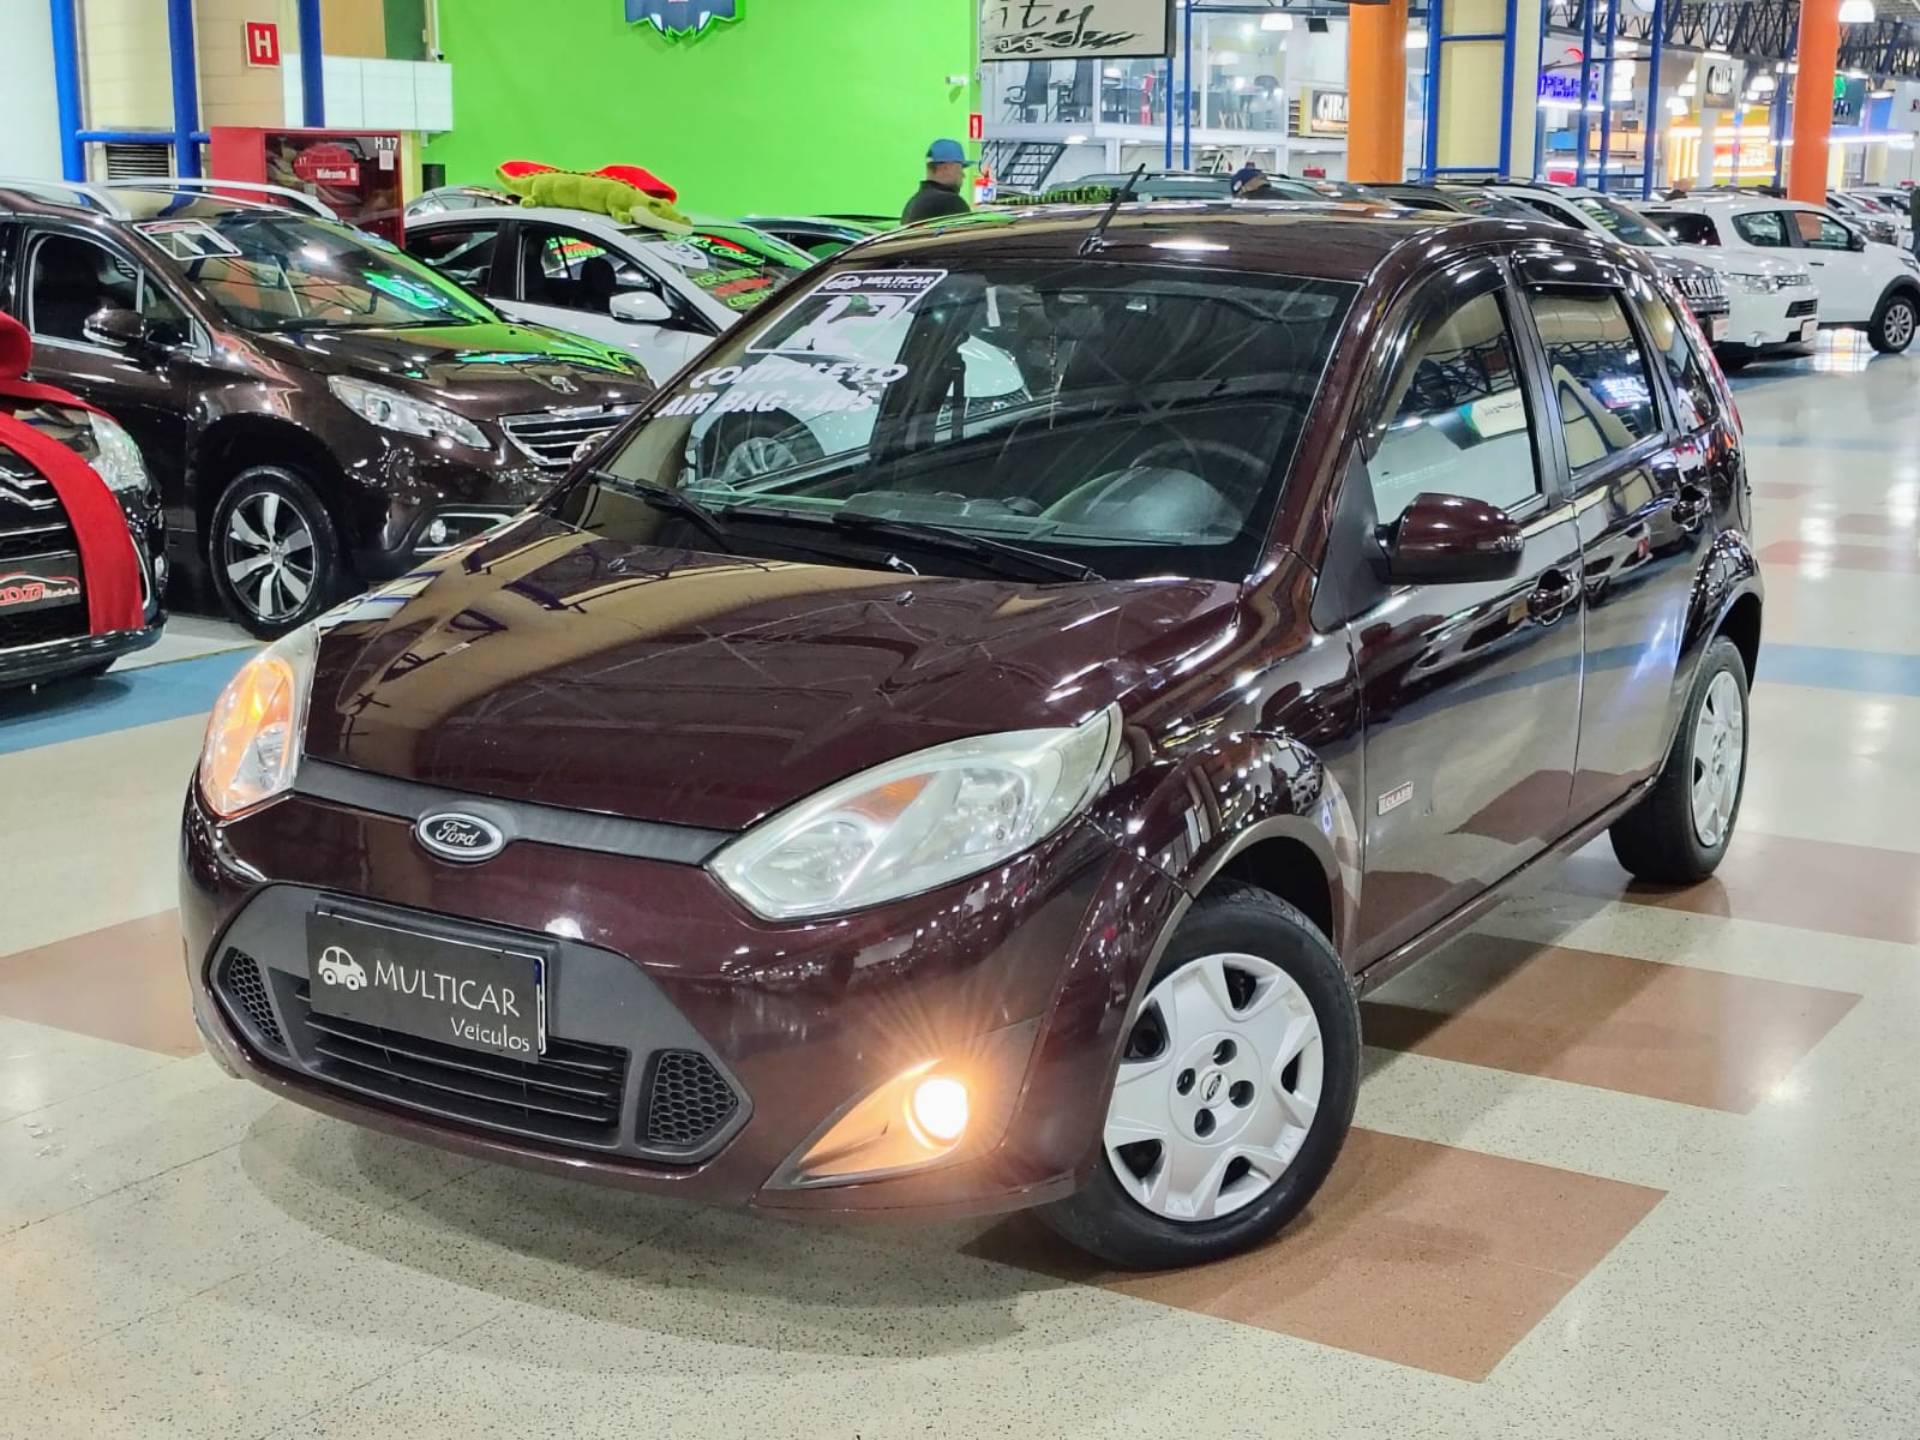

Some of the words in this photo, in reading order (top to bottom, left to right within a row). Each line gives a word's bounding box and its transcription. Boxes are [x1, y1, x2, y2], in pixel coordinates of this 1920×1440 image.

[254, 30, 272, 58] H
[690, 364, 908, 387] COMPLETO
[654, 393, 716, 417] AIR
[719, 391, 788, 412] BAG
[436, 820, 480, 846] Ford
[374, 959, 521, 1018] MULTICAR
